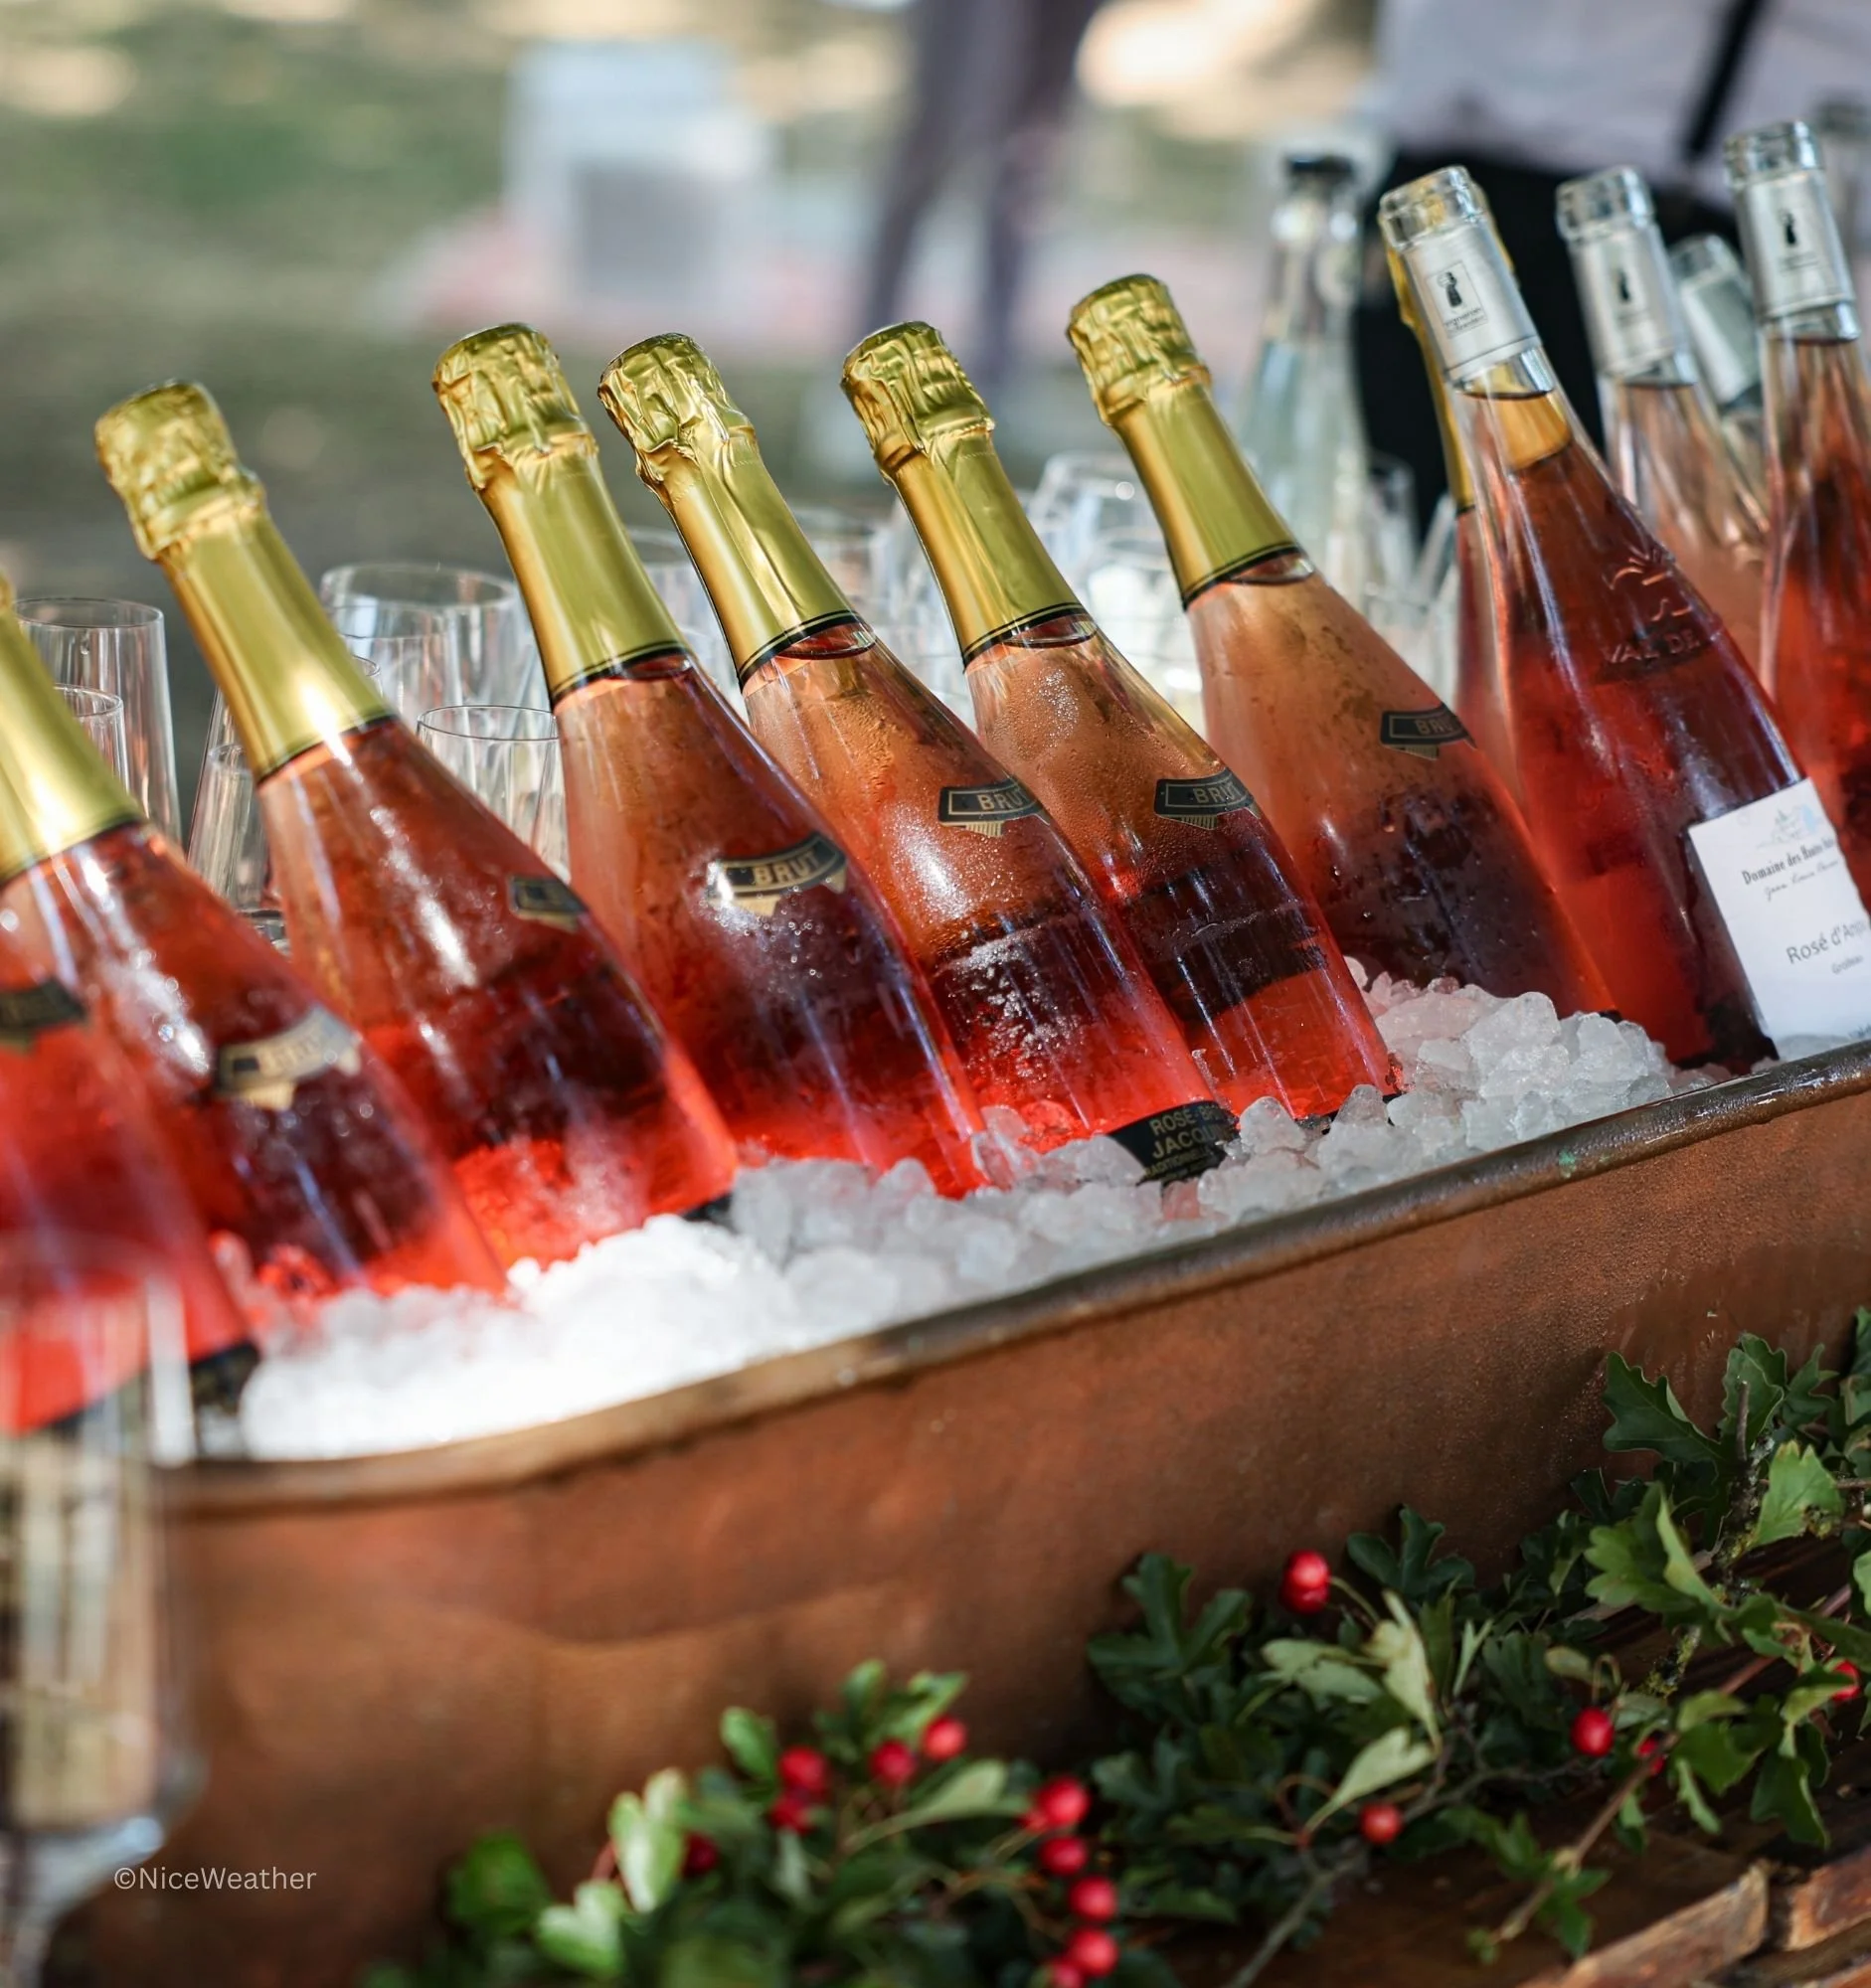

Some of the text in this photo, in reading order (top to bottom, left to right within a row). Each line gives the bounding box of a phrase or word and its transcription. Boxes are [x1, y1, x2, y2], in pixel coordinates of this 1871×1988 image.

[752, 850, 818, 888] BRUT
[1741, 861, 1786, 886] Domaine
[1786, 852, 1803, 868] des
[1786, 931, 1829, 964] Rosé
